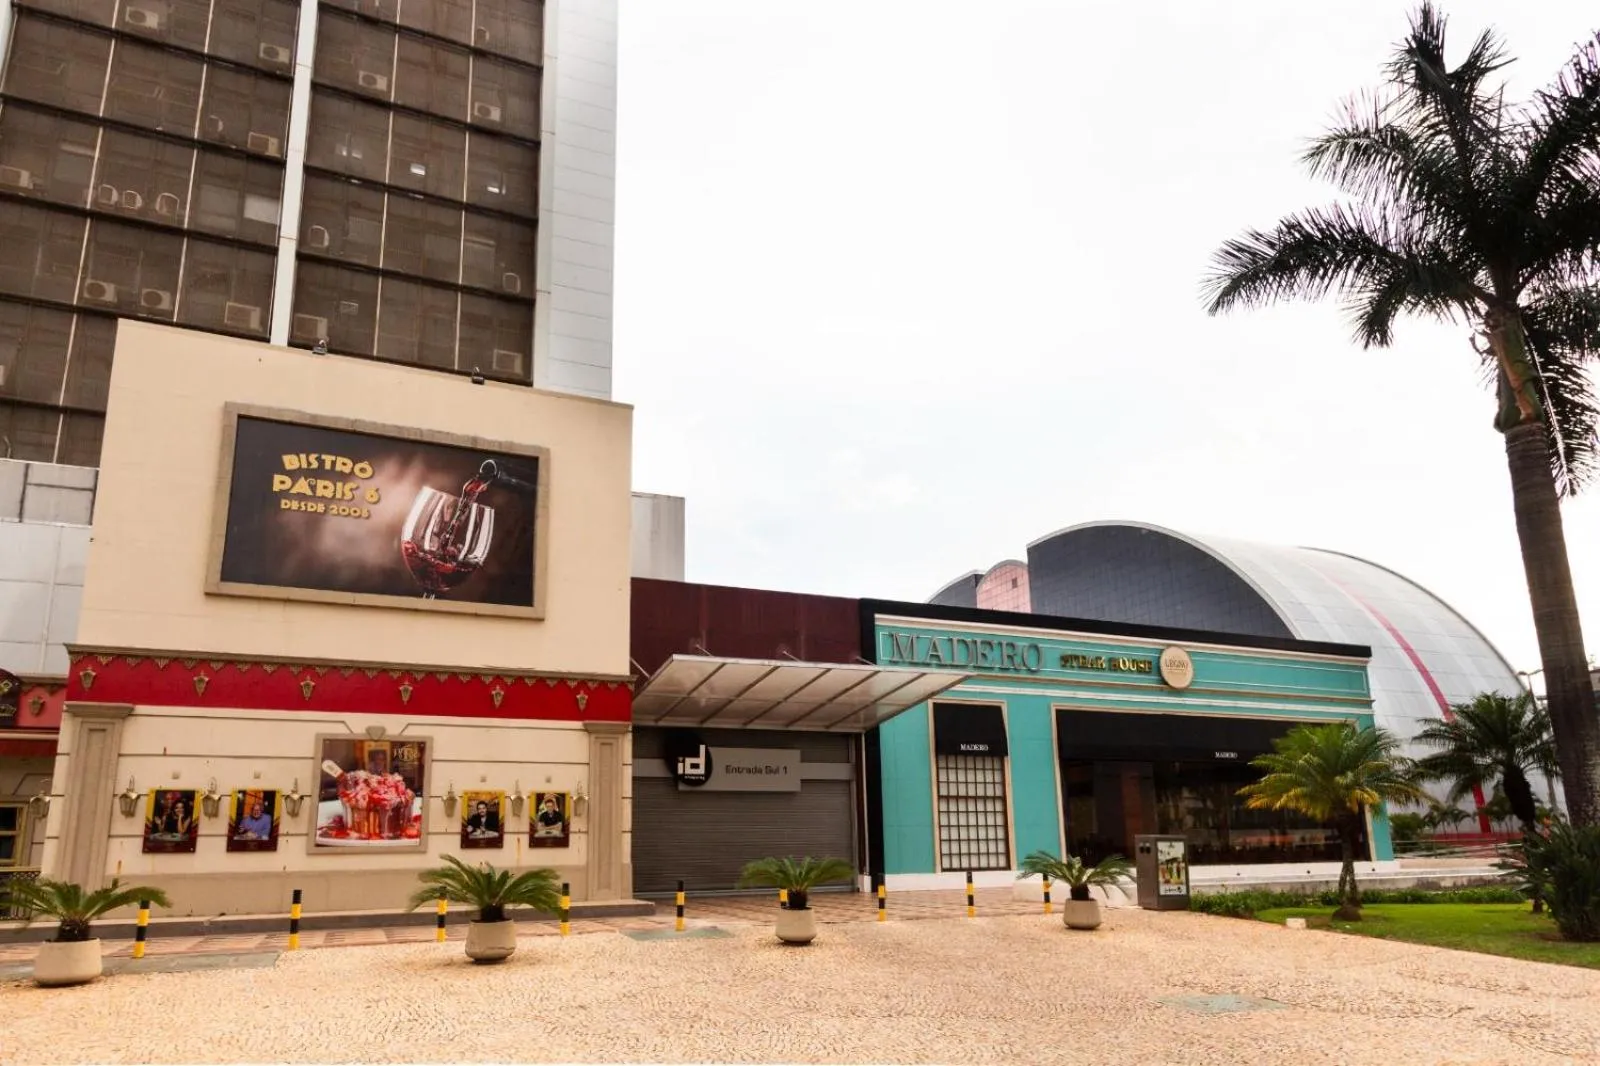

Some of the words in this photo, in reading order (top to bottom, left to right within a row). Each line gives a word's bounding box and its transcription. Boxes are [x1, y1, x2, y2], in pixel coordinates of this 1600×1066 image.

[273, 474, 360, 501] PARIS
[365, 487, 381, 504] 6
[280, 499, 326, 513] DESDE
[888, 632, 1043, 672] MADERO
[1060, 655, 1106, 669] STEAK
[1108, 657, 1152, 673] HOUSE
[960, 743, 989, 751] MADERO
[725, 764, 763, 775] Entrada
[765, 765, 780, 775] Sul
